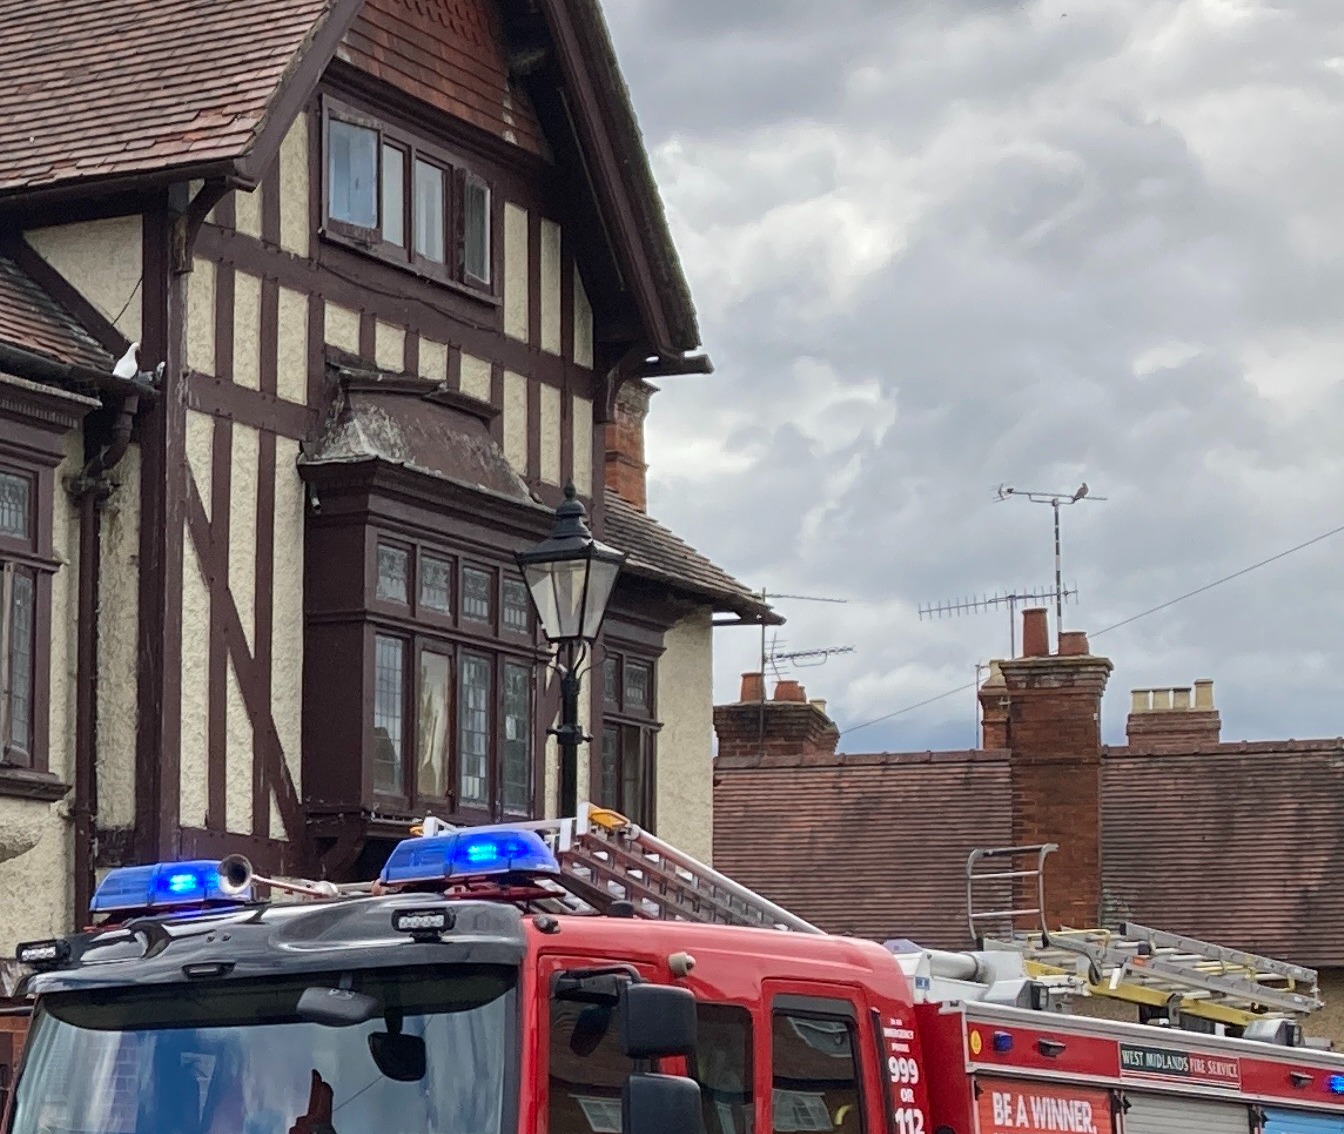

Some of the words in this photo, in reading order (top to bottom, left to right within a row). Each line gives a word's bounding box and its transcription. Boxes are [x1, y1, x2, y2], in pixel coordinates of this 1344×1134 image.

[888, 1056, 919, 1085] 999
[1121, 1049, 1144, 1066] WEST
[1146, 1053, 1189, 1072] MIDLANDS
[1189, 1058, 1206, 1074] FIRE
[1207, 1061, 1238, 1078] SERVICE
[900, 1087, 915, 1103] OR
[992, 1092, 1013, 1127] BE
[1016, 1095, 1029, 1128] A
